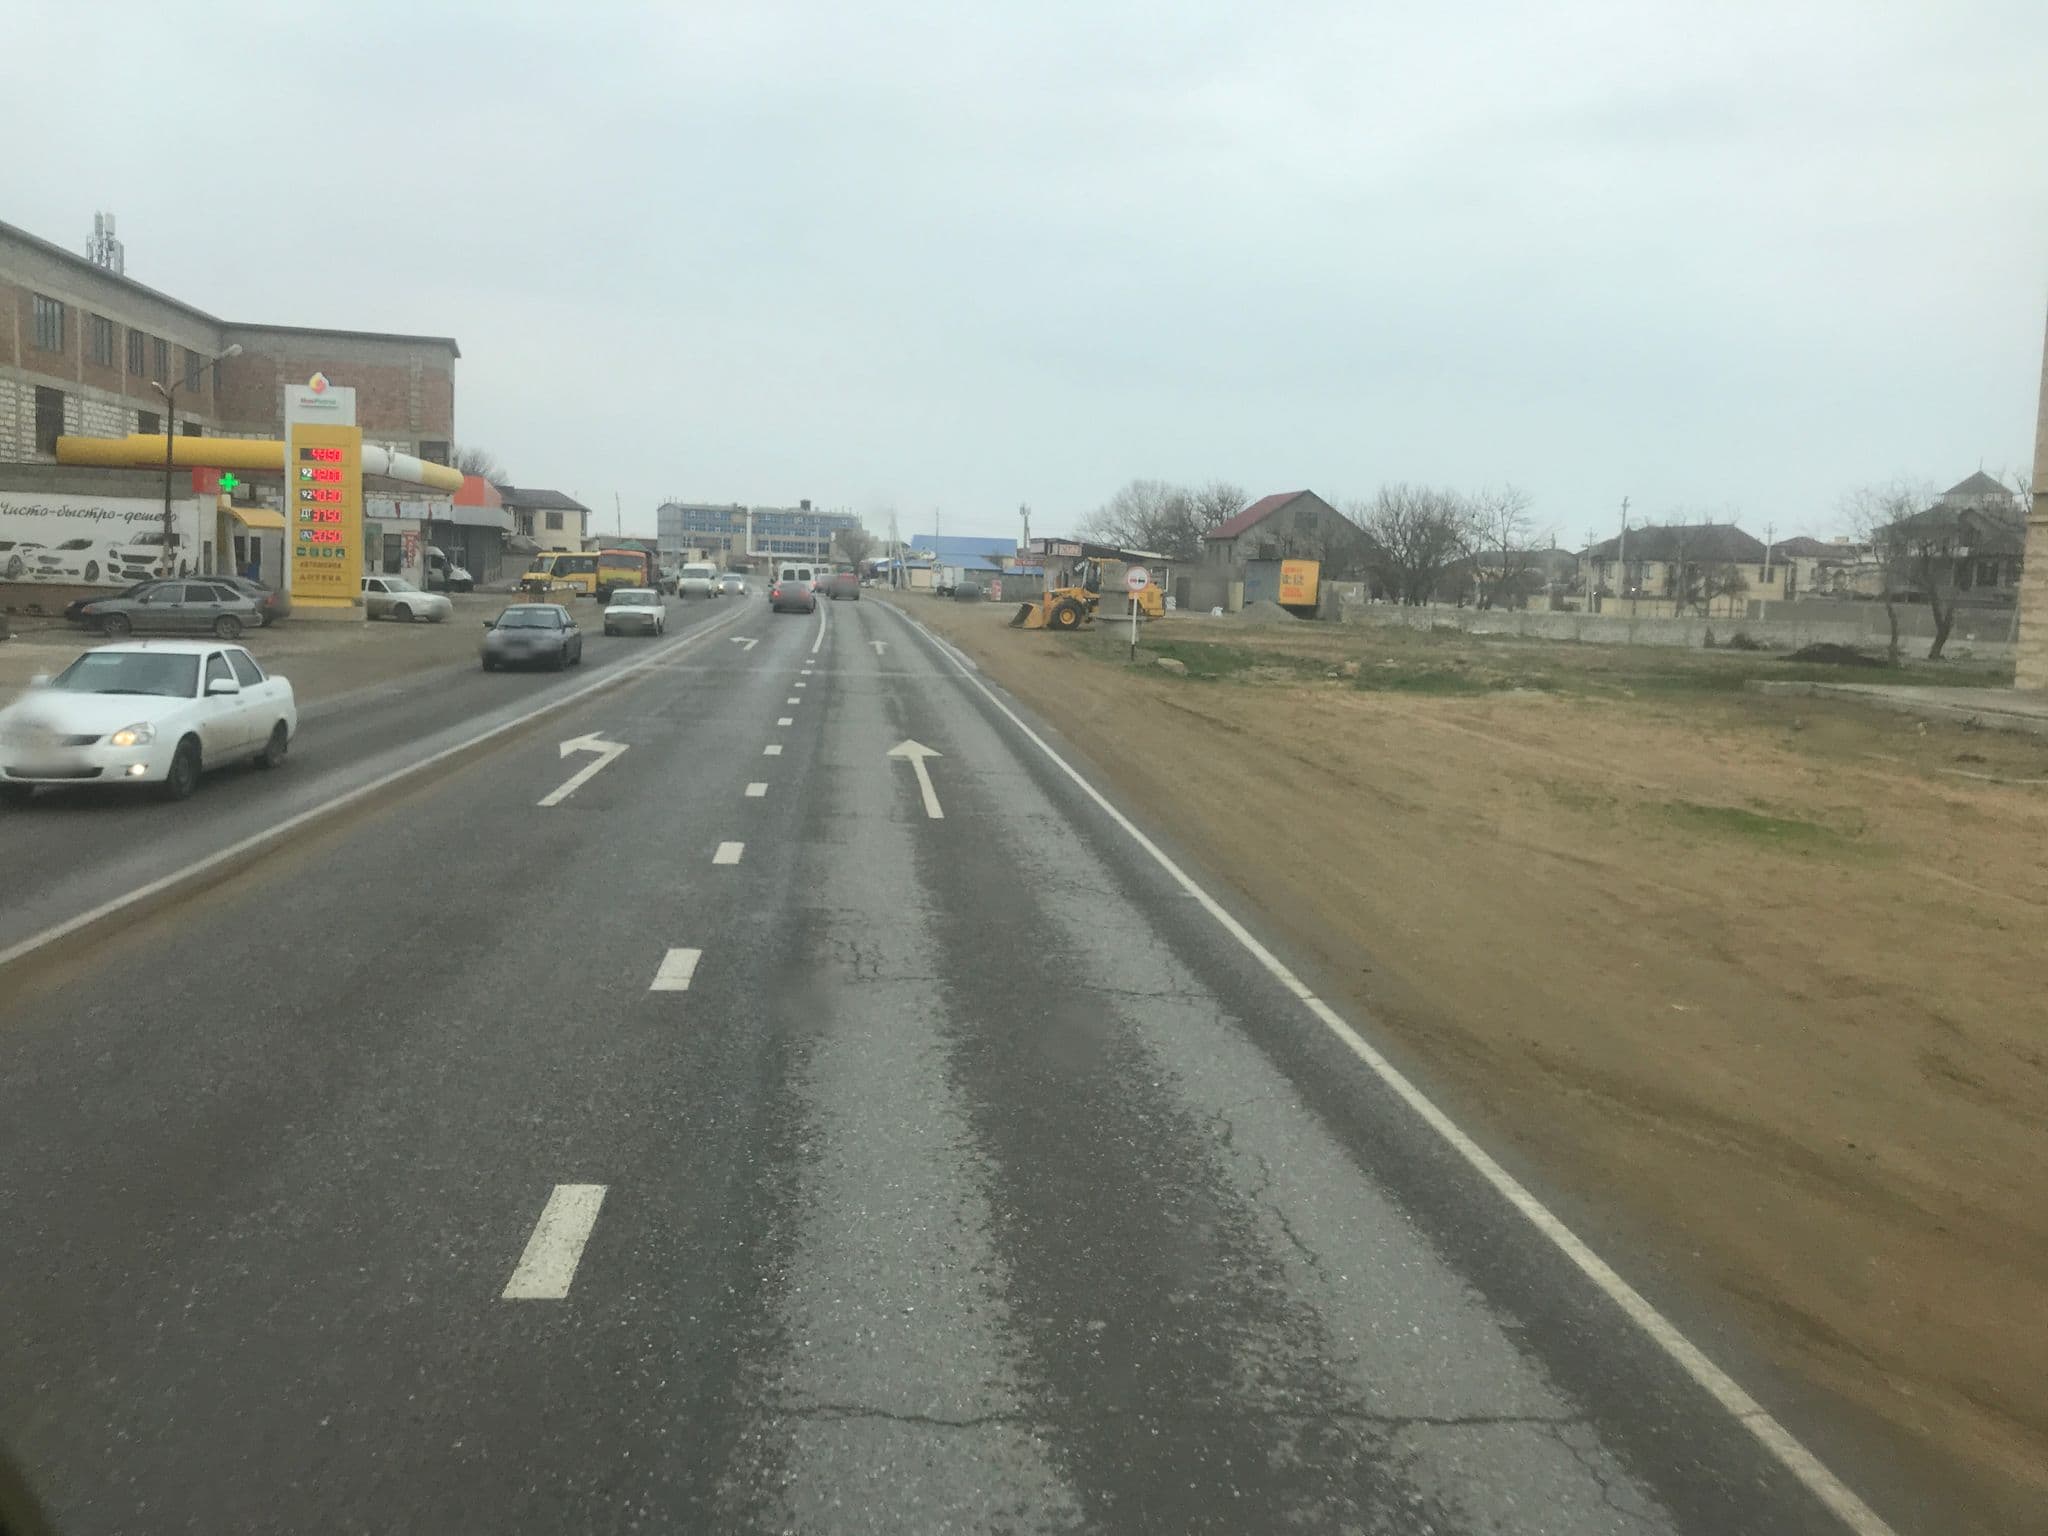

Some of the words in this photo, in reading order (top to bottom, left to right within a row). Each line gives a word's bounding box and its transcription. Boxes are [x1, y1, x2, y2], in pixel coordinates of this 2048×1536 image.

[302, 468, 312, 478] 92
[302, 490, 312, 499] 92
[0, 502, 177, 525] Чисто-быстро-дешео
